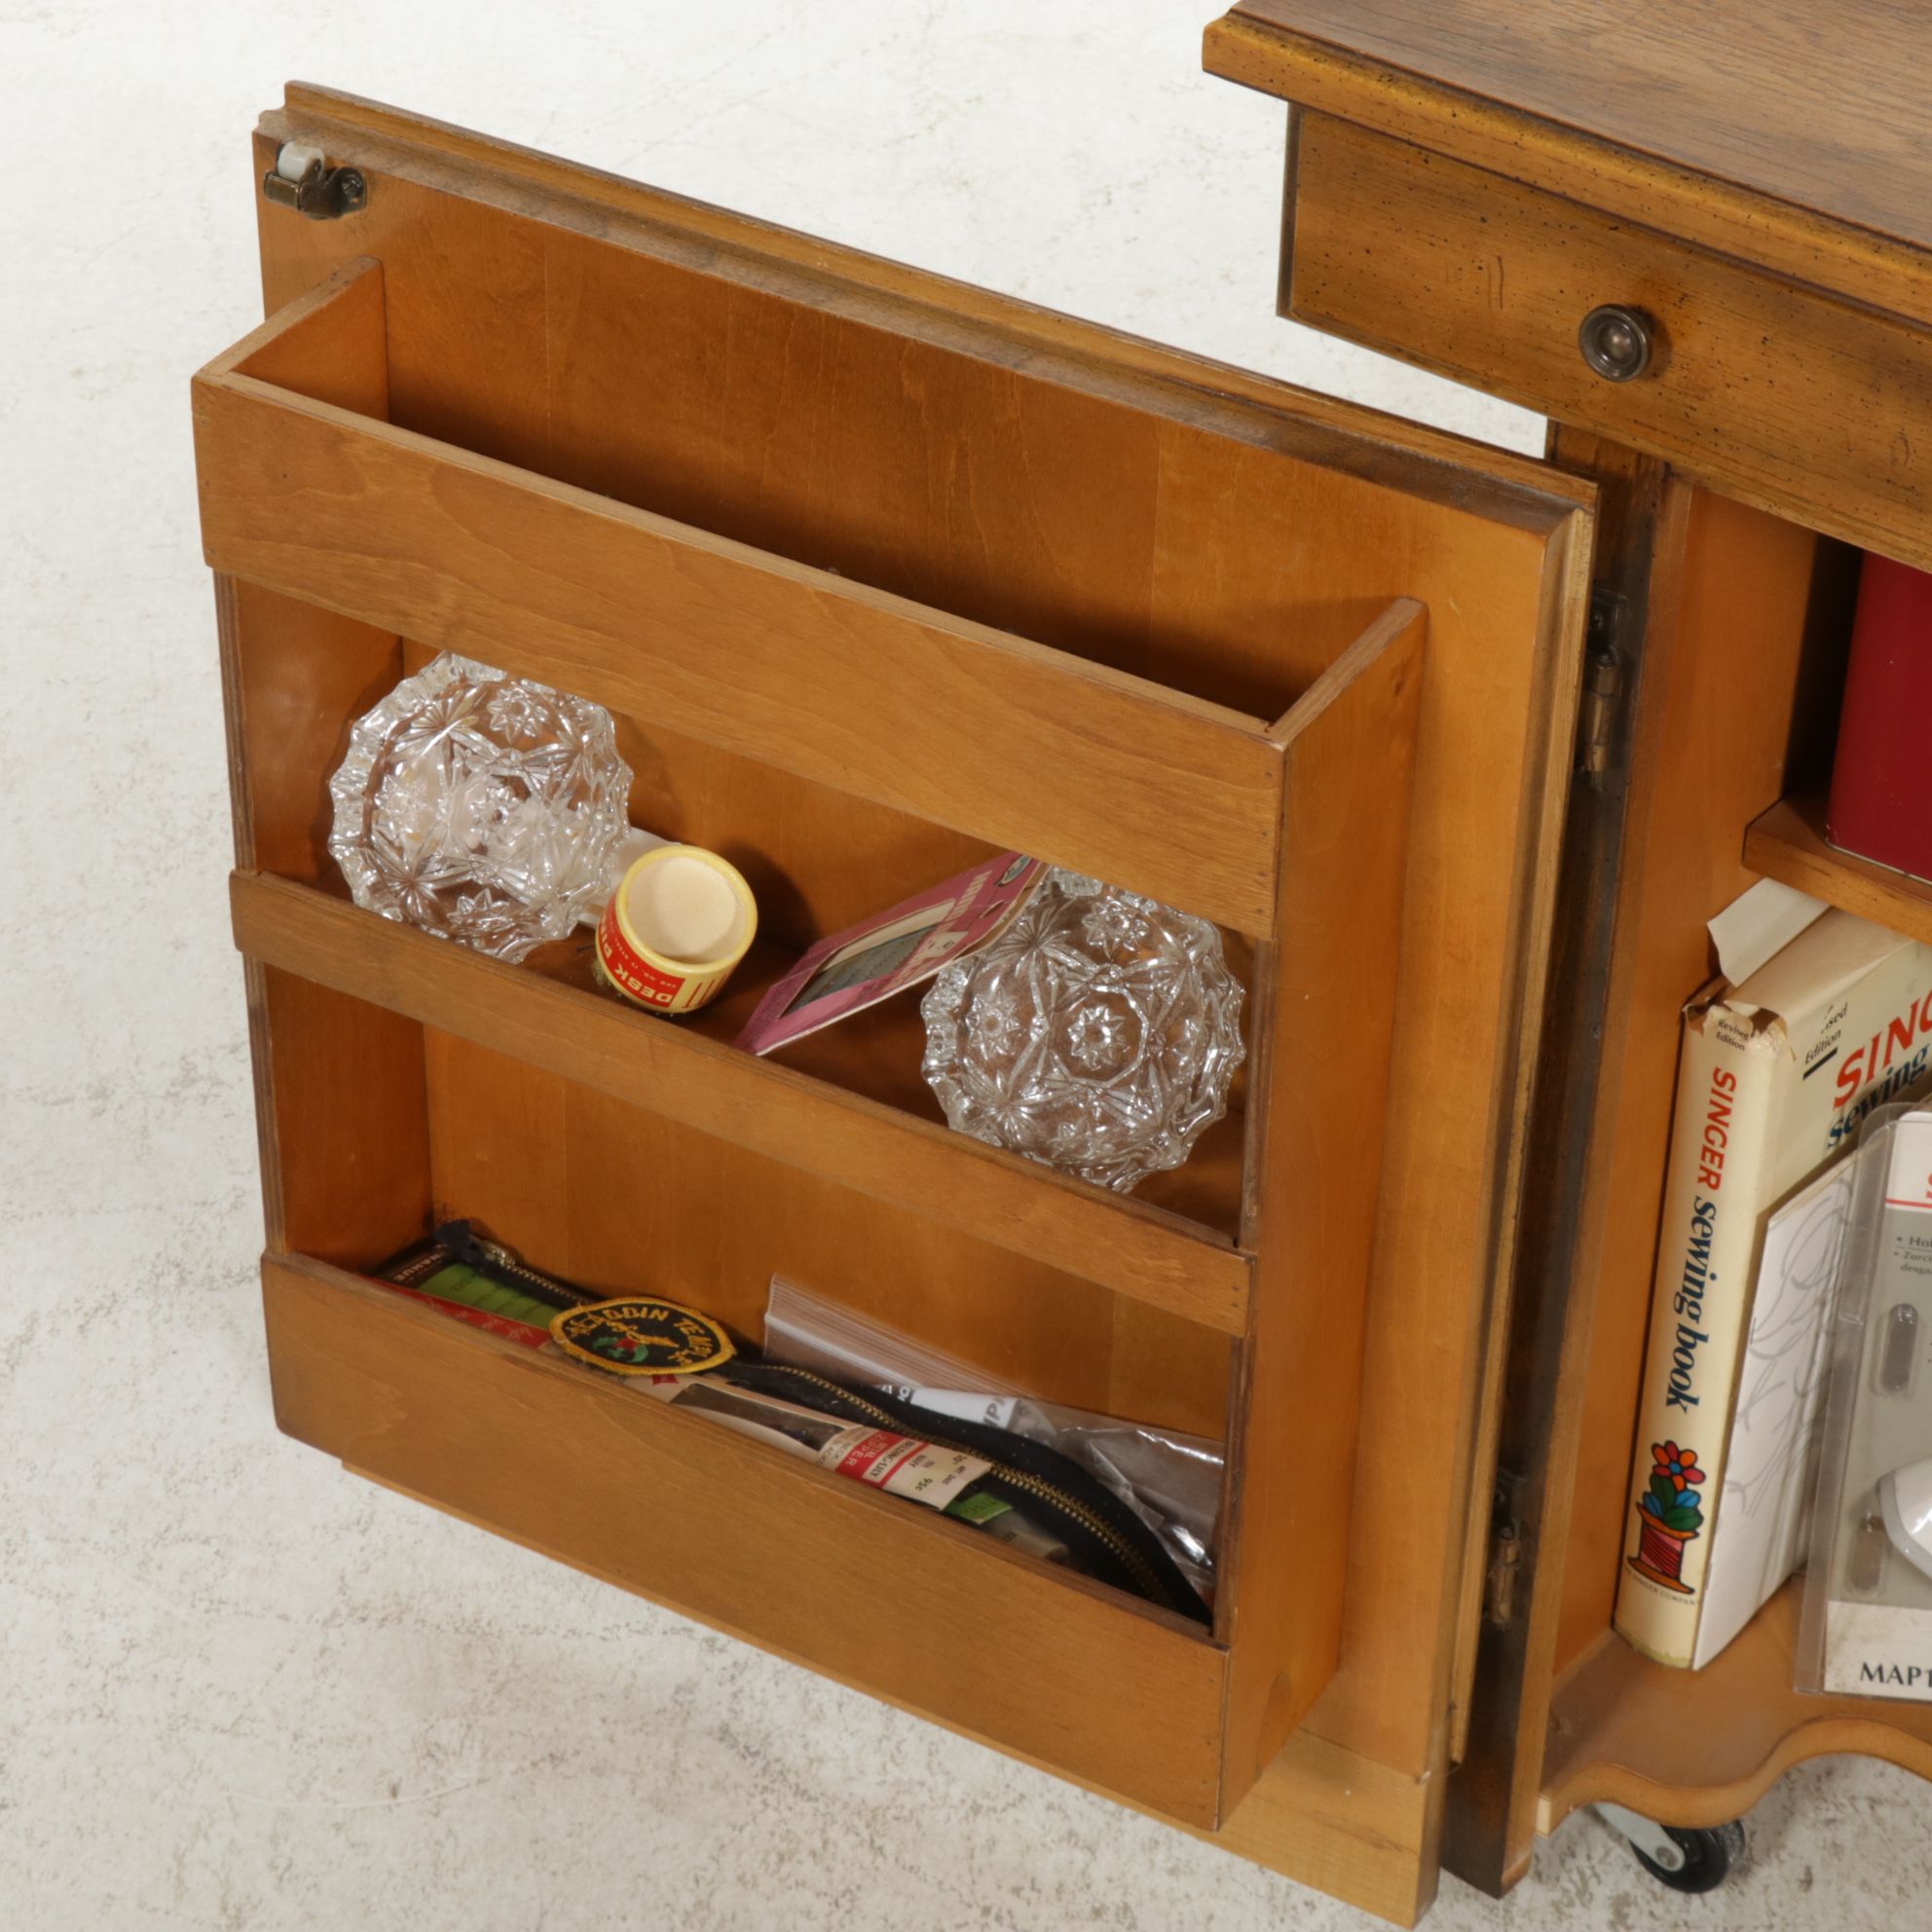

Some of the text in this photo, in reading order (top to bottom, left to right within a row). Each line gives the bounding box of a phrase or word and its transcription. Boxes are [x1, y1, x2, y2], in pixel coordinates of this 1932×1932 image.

[613, 963, 674, 1004] DESK
[1716, 1031, 1746, 1053] Edition
[1717, 1019, 1750, 1042] Revised
[1804, 1028, 1842, 1065] Edition
[1828, 1042, 1932, 1149] sewing
[1666, 1066, 1736, 1415] SINGER sewing book
